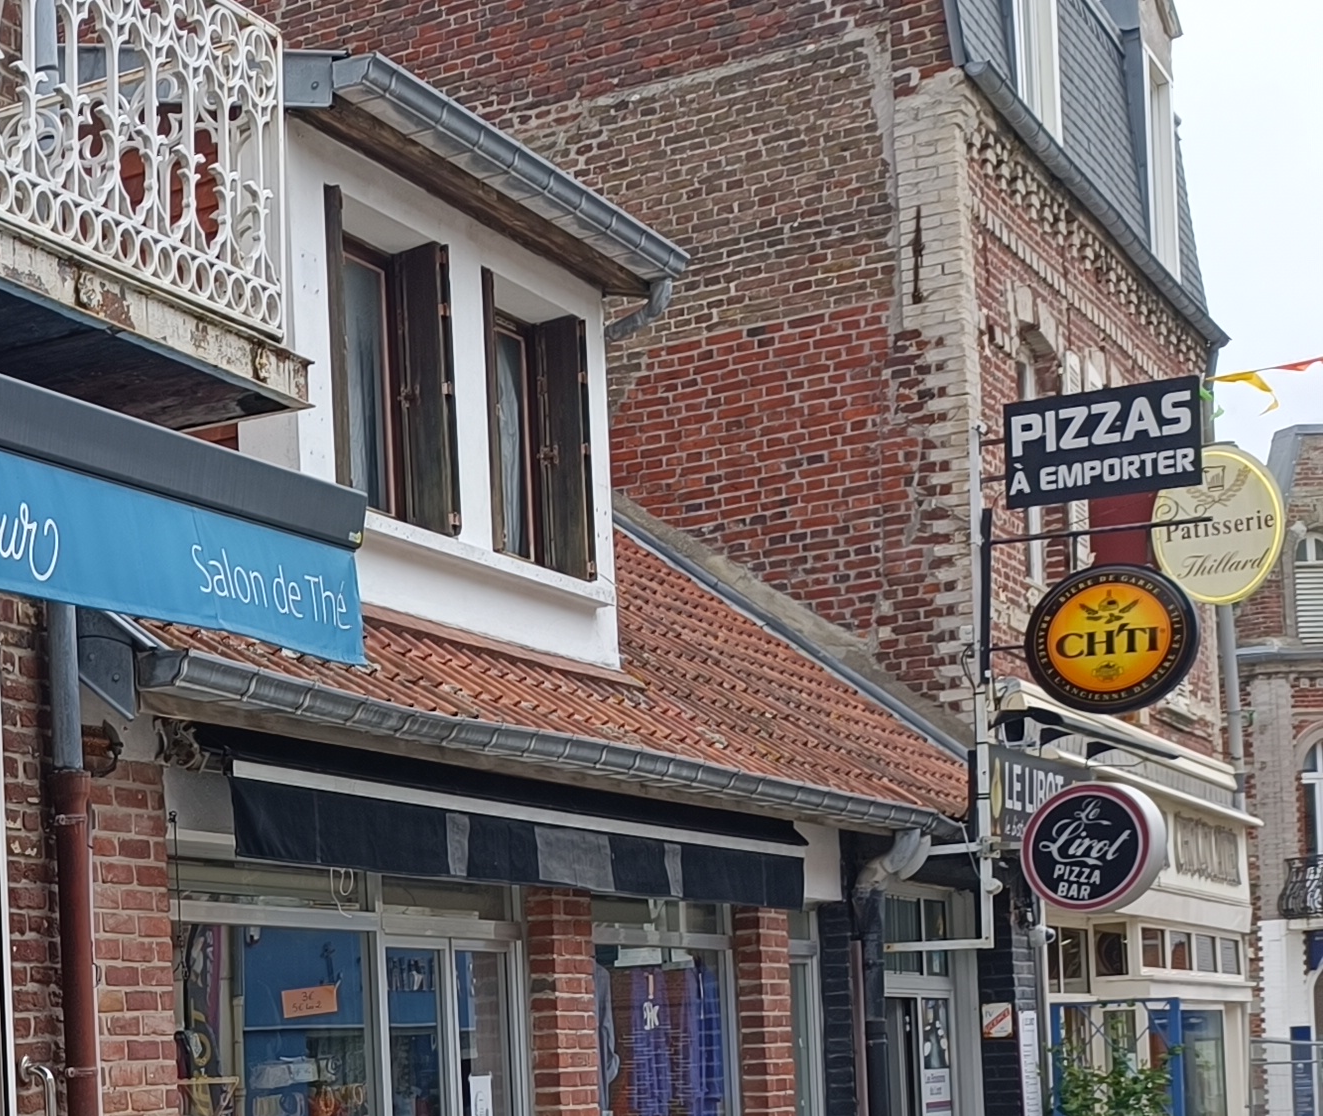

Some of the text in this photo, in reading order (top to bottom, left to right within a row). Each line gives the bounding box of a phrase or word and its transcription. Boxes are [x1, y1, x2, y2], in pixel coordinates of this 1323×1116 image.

[1011, 390, 1193, 457] PIZZAS
[1010, 447, 1195, 497] À EMPORTER
[1177, 548, 1270, 579] Thillard
[192, 543, 352, 631] Salon de Thé
[1120, 575, 1163, 595] GARDE
[1005, 762, 1022, 811] LE
[1074, 798, 1112, 826] Le
[1039, 818, 1132, 866] Lirot
[1053, 864, 1101, 885] PIZZA
[1057, 882, 1091, 900] BAR
